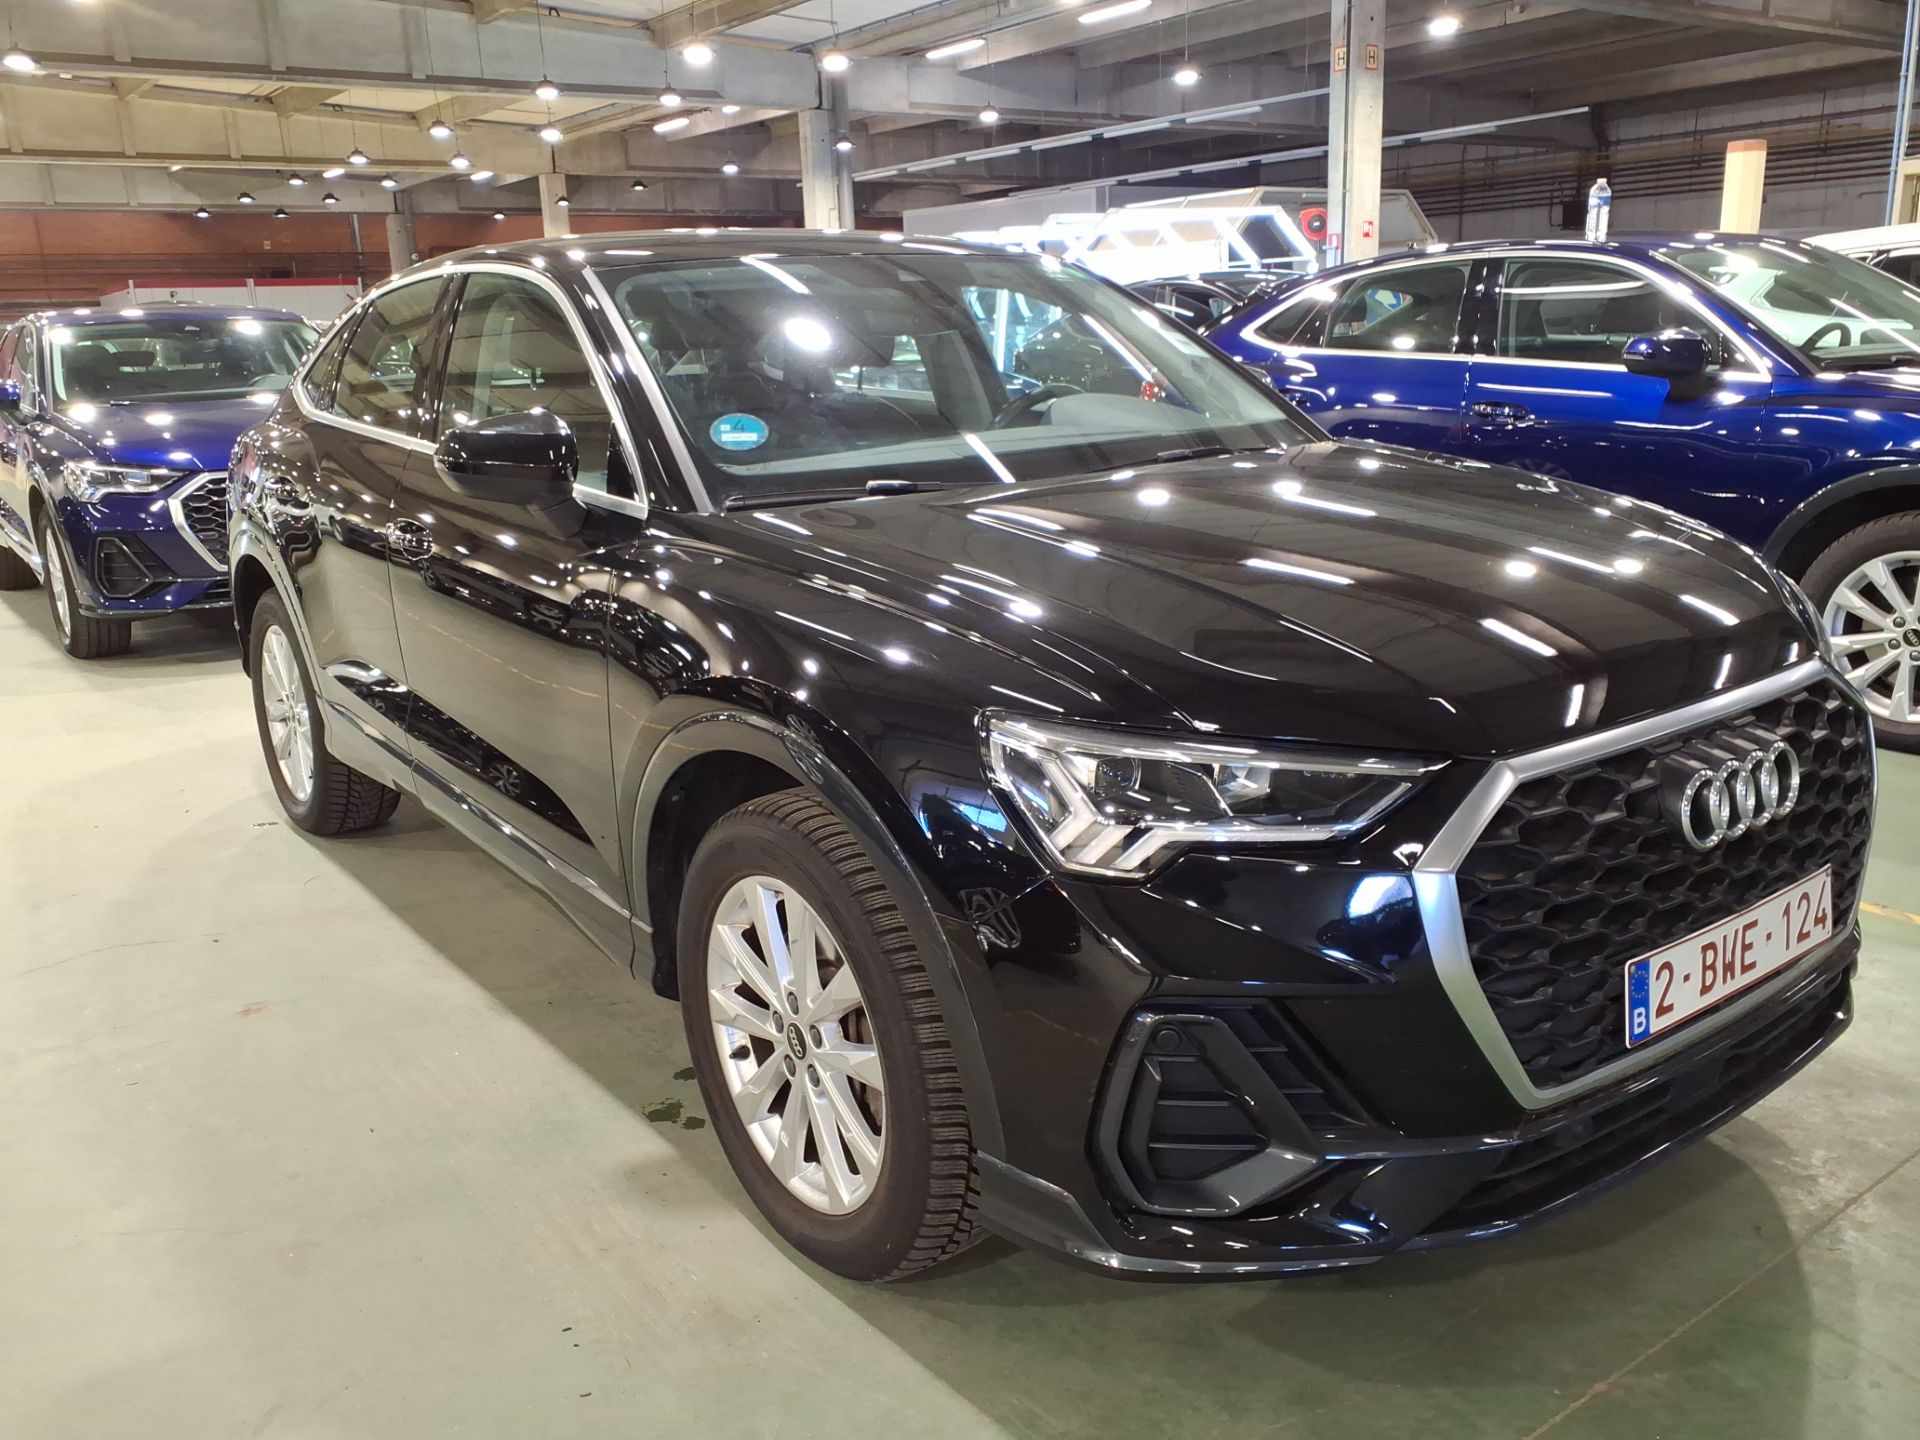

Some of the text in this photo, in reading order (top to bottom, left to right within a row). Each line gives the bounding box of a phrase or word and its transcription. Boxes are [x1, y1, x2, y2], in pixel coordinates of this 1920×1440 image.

[1337, 50, 1346, 67] H
[1368, 48, 1376, 65] H
[732, 418, 746, 432] 4
[1655, 880, 1828, 1020] 2-BWE-124
[1633, 1007, 1647, 1035] B
